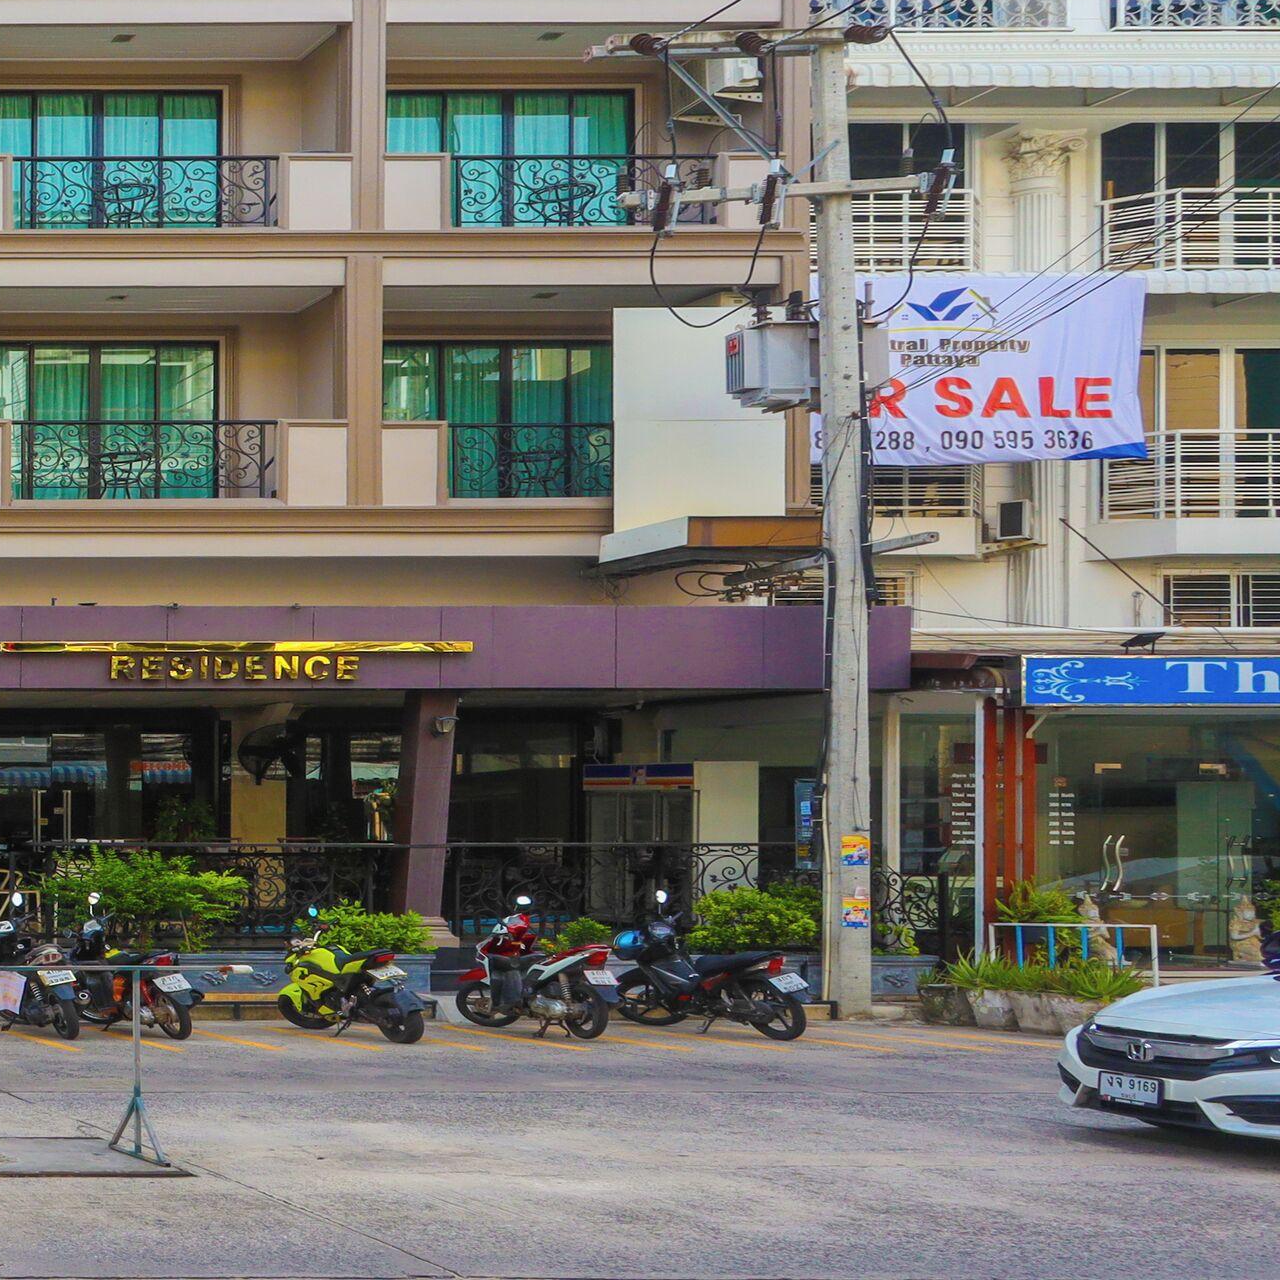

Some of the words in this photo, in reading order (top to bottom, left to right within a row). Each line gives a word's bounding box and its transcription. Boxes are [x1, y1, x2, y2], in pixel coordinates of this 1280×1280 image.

[889, 338, 928, 353] tral
[939, 338, 1031, 354] Property
[900, 353, 980, 367] Pattaya
[934, 376, 1114, 419] SALE
[941, 430, 984, 450] 090
[993, 430, 1034, 450] 595
[1043, 429, 1093, 450] 3636
[109, 654, 361, 682] RESIDENCE
[1129, 1079, 1157, 1093] 9169
